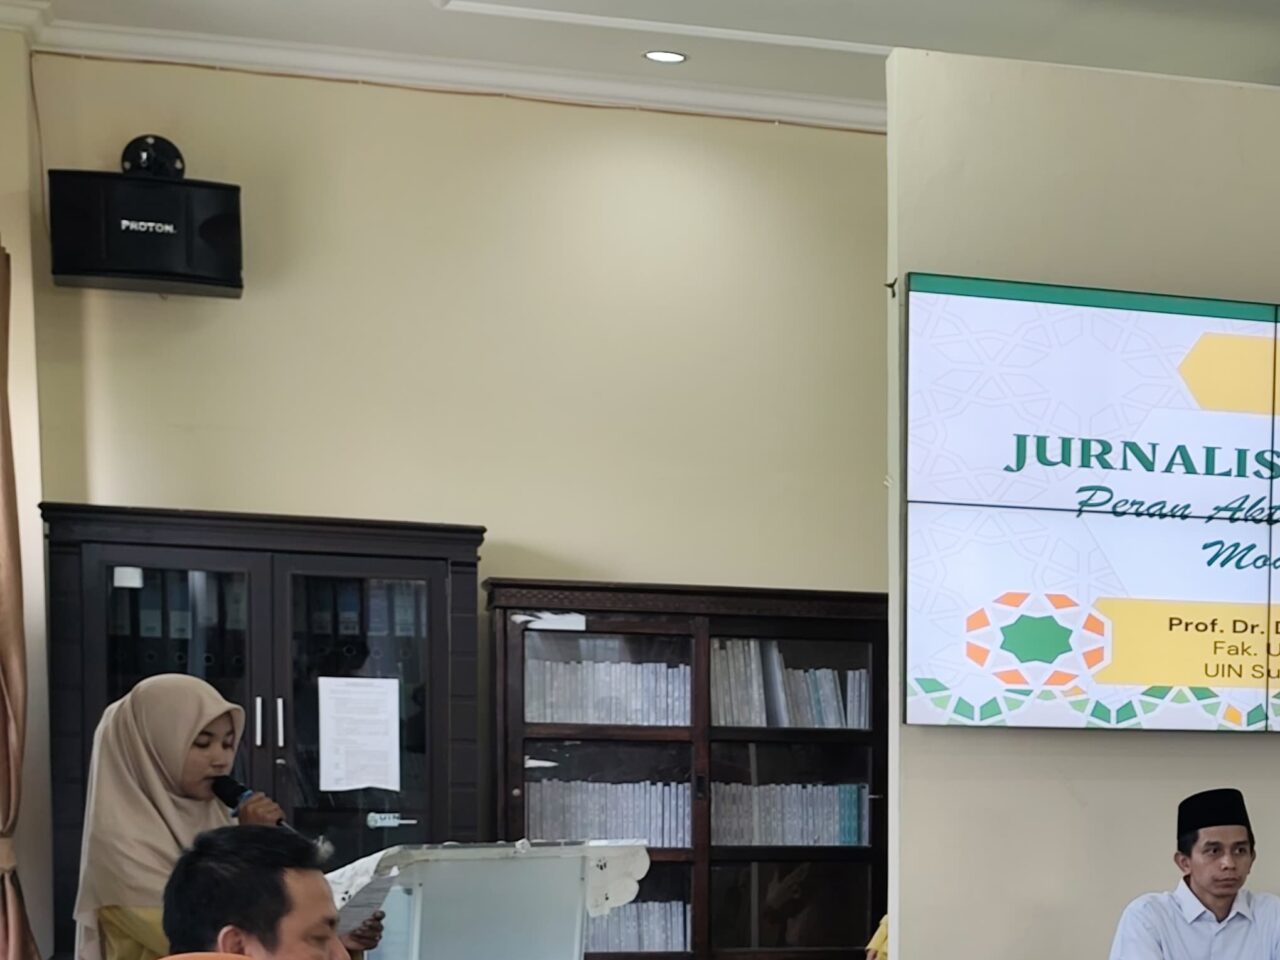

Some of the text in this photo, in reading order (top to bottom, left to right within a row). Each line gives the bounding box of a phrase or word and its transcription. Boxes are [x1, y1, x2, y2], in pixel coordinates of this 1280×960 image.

[1075, 485, 1192, 520] Peran
[1168, 617, 1224, 633] Prof.
[1232, 619, 1265, 635] Dr.
[1213, 641, 1258, 656] Fak.
[1204, 662, 1243, 679] UIN
